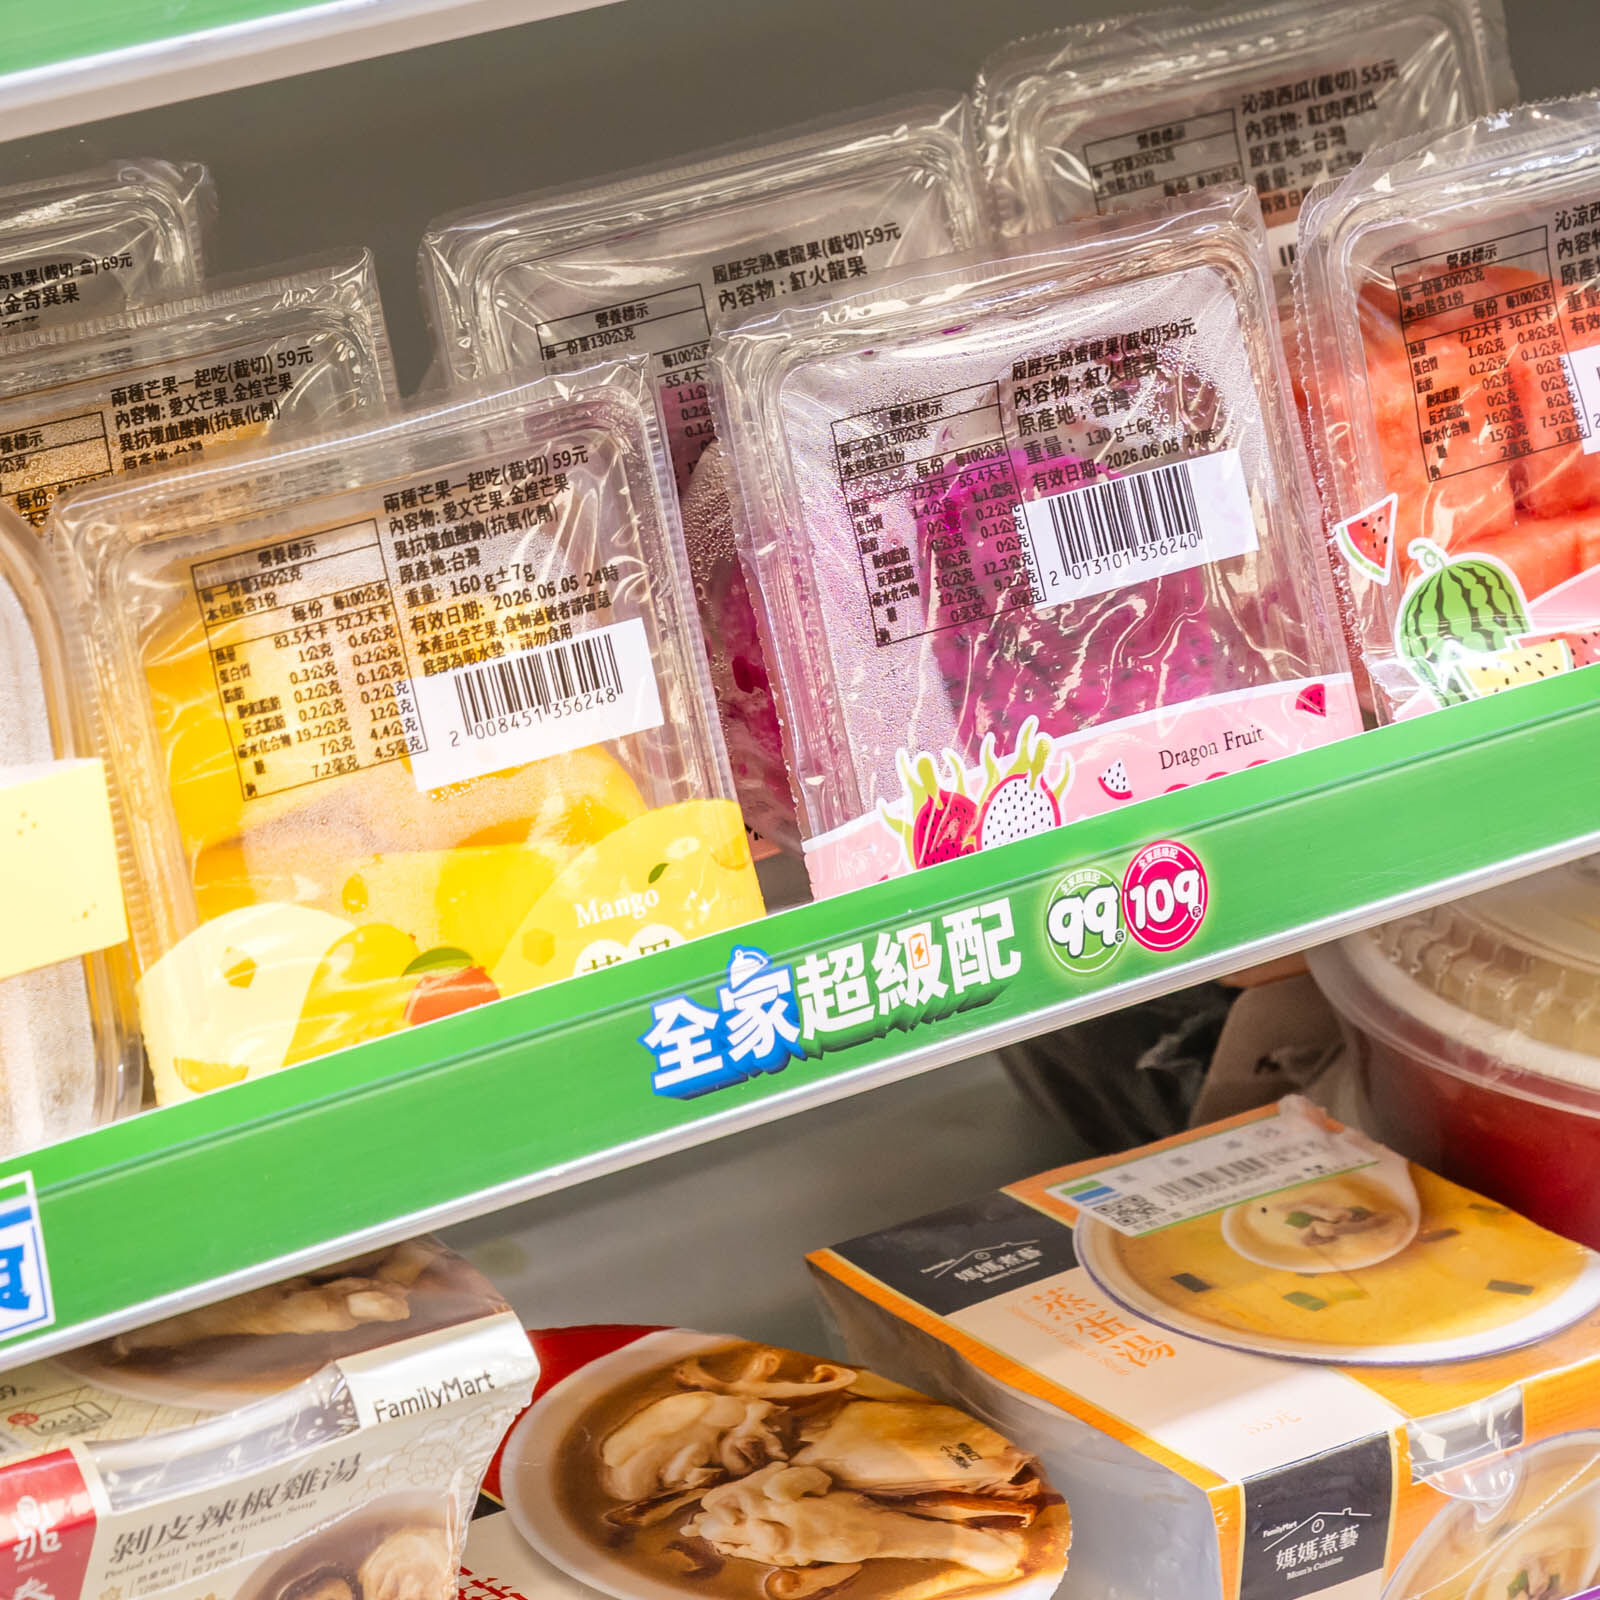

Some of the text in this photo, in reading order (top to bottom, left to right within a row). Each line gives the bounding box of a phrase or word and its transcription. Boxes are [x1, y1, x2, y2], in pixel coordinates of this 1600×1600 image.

[1360, 59, 1399, 87] 55元
[1244, 92, 1378, 142] 內容物: 紅肉西瓜
[1248, 126, 1347, 168] 原產地: 台灣
[101, 251, 134, 273] 69元
[1446, 244, 1497, 267] 營養標示
[595, 303, 650, 330] 營養標示
[109, 344, 314, 408] 兩種芒果一起吃(截切) 59元
[114, 404, 168, 427] 內容物:
[1086, 428, 1110, 447] 130
[383, 445, 589, 515] 兩種芒果一起吃(截切) 59元
[1031, 437, 1180, 492] 有效日期: 2026.06.05
[389, 474, 570, 538] 內容物: 愛文芒果.金煌芒果
[399, 546, 481, 584] 原產地:台灣
[1049, 532, 1198, 587] 2 013101 356240
[405, 562, 536, 609] 重量: 160 g±7g
[409, 565, 620, 635] 有效日期: 2026.06.05 24時
[449, 687, 618, 747] 2 008451 356248
[1158, 724, 1265, 772] Dragon Fruit
[573, 887, 661, 929] Mango
[1047, 869, 1202, 954] 99 109
[645, 897, 1022, 1091] 全家超級配
[372, 1369, 496, 1424] FamilyMart
[110, 1451, 361, 1563] 剝皮辣椒雞湯
[286, 1500, 317, 1515] Soup
[1262, 1521, 1298, 1538] FamilyMart
[1276, 1524, 1360, 1571] 媽媽煮藝
[1287, 1556, 1344, 1580] Mom's Cuisine
